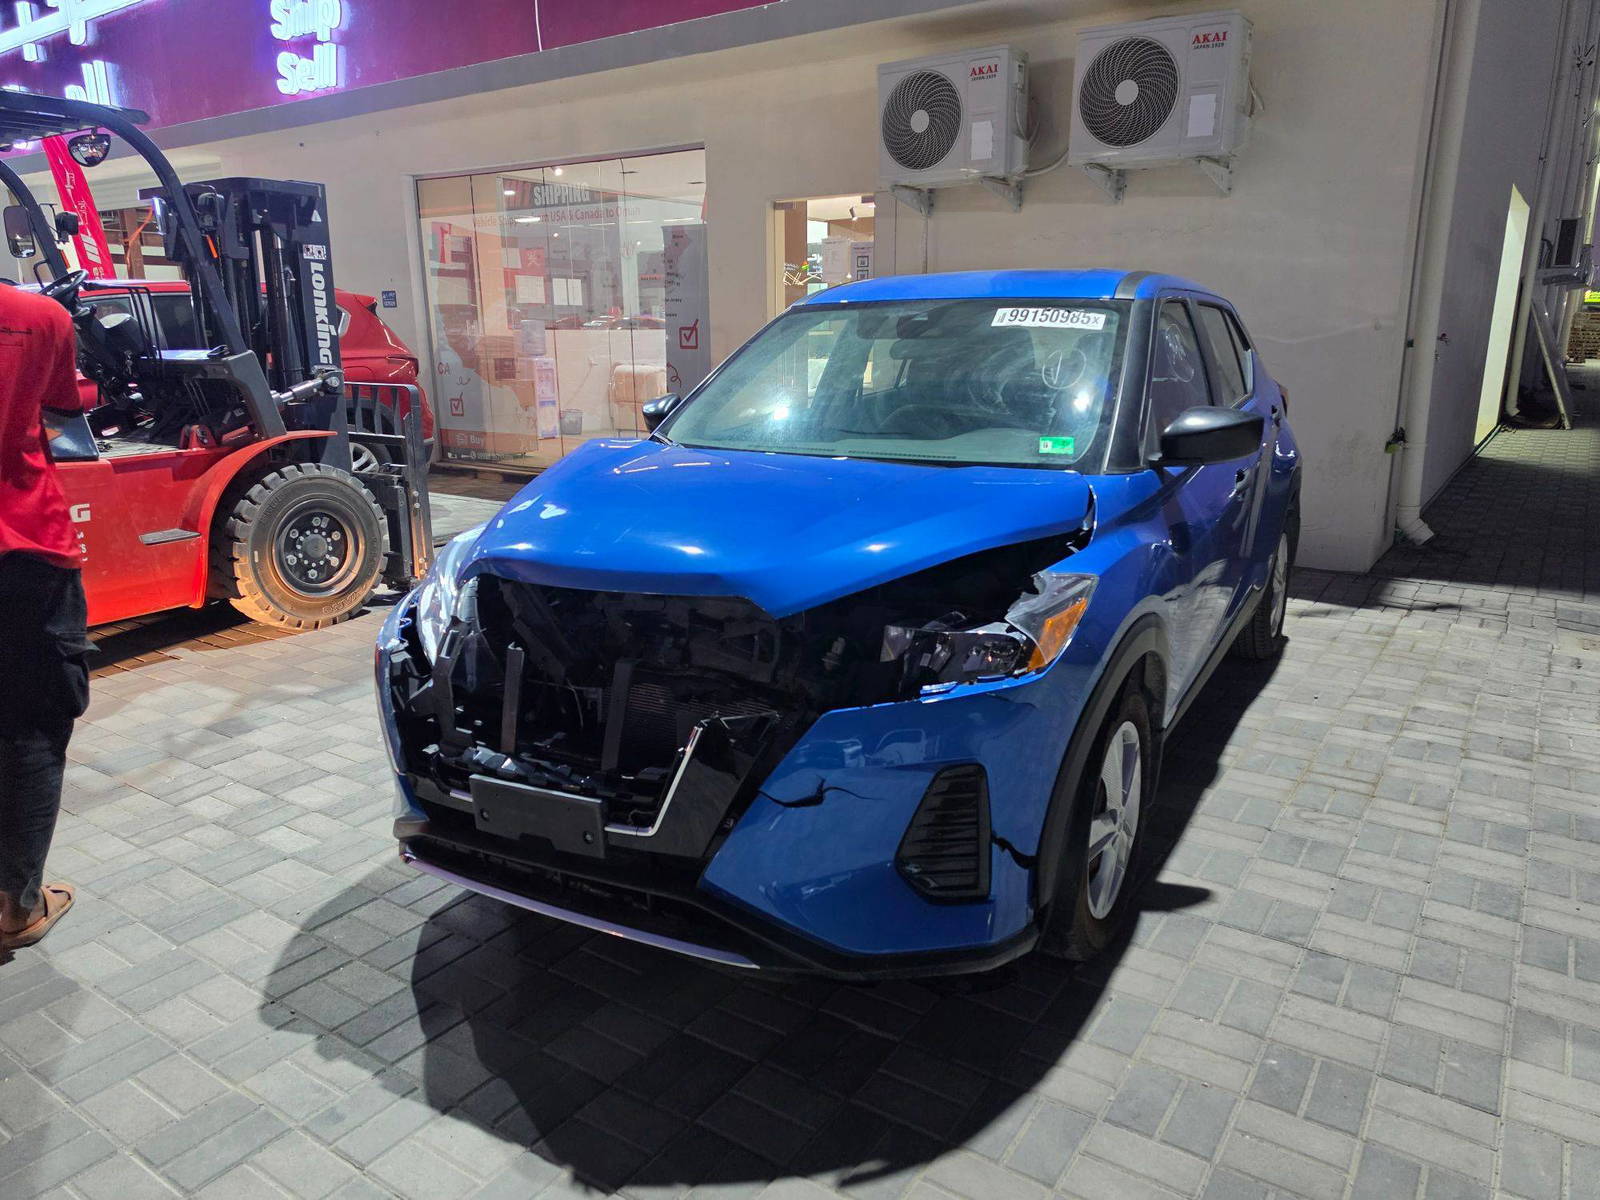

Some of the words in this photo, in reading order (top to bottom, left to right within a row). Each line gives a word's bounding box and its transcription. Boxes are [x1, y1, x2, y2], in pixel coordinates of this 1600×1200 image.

[1192, 31, 1229, 44] AKAI
[277, 42, 337, 95] Sell
[970, 64, 999, 77] AKAI
[533, 182, 590, 206] SHIPPING
[551, 212, 566, 224] USA
[575, 208, 603, 220] Canada
[605, 208, 615, 218] to
